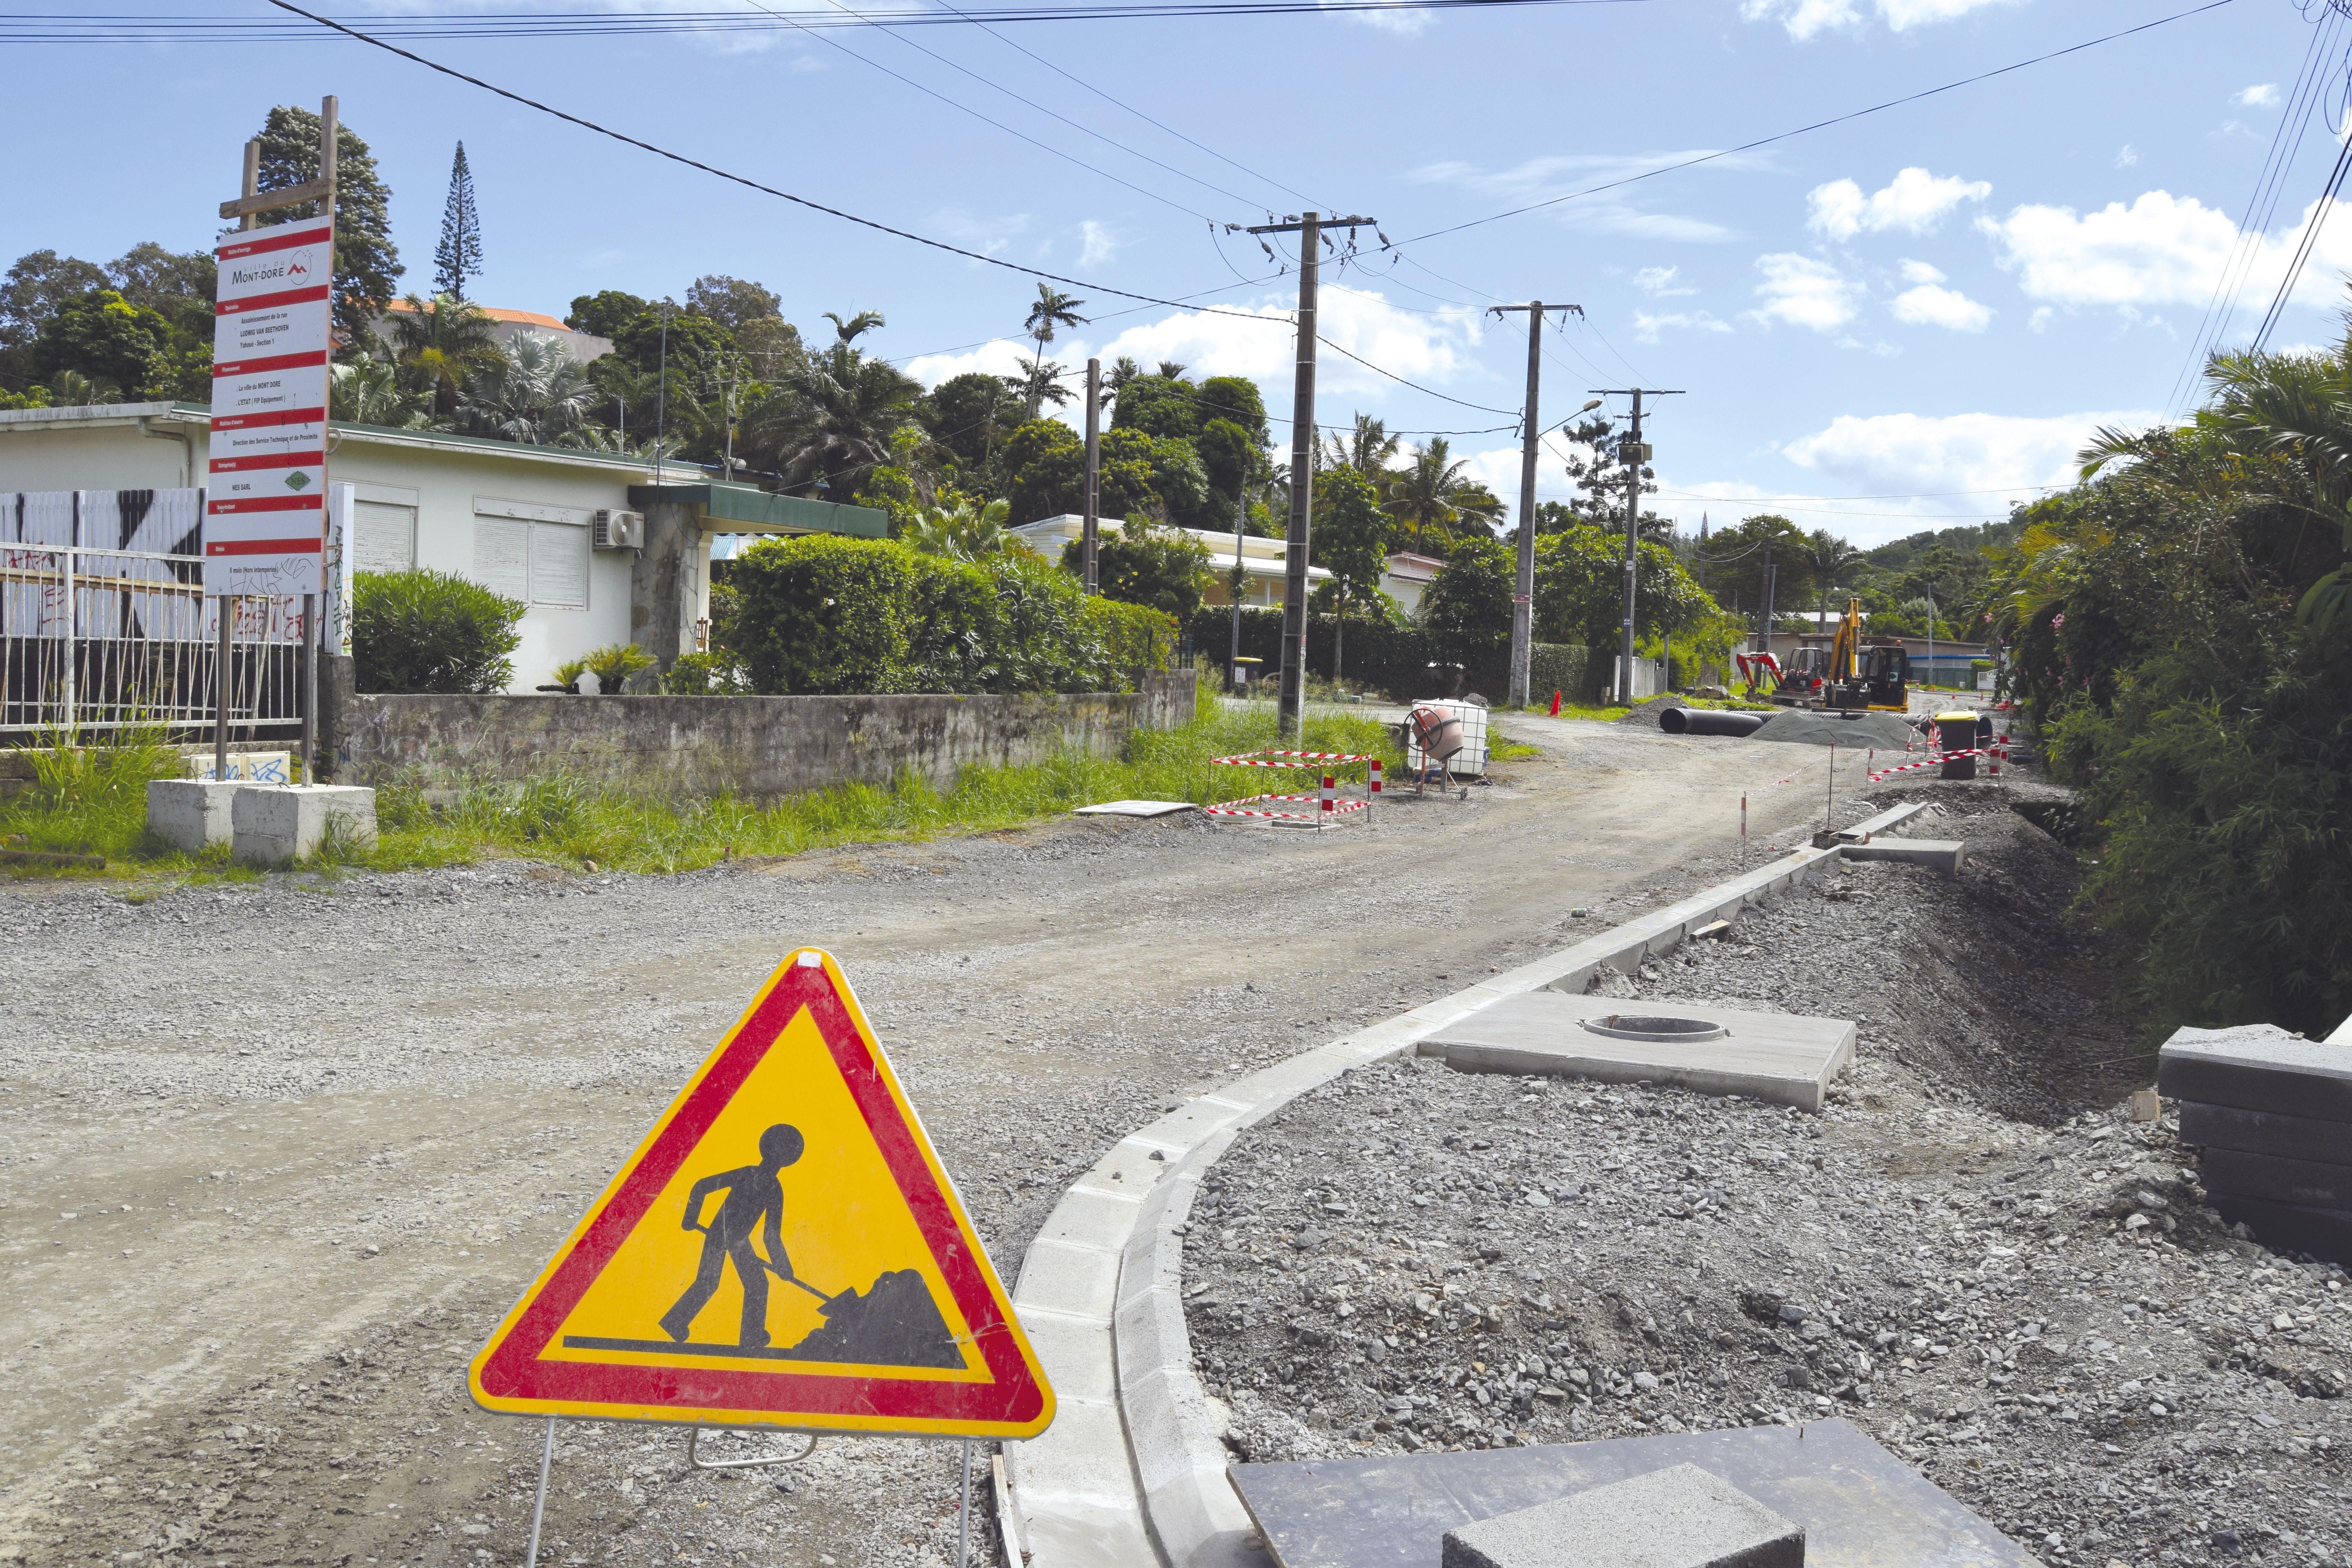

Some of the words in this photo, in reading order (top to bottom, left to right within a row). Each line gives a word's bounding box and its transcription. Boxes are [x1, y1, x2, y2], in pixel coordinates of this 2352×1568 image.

[244, 263, 267, 272] ville
[232, 268, 284, 285] MONT-DORE
[241, 314, 270, 324] Assainissement
[265, 324, 289, 334] BEETHOVEN
[291, 477, 305, 485] NES
